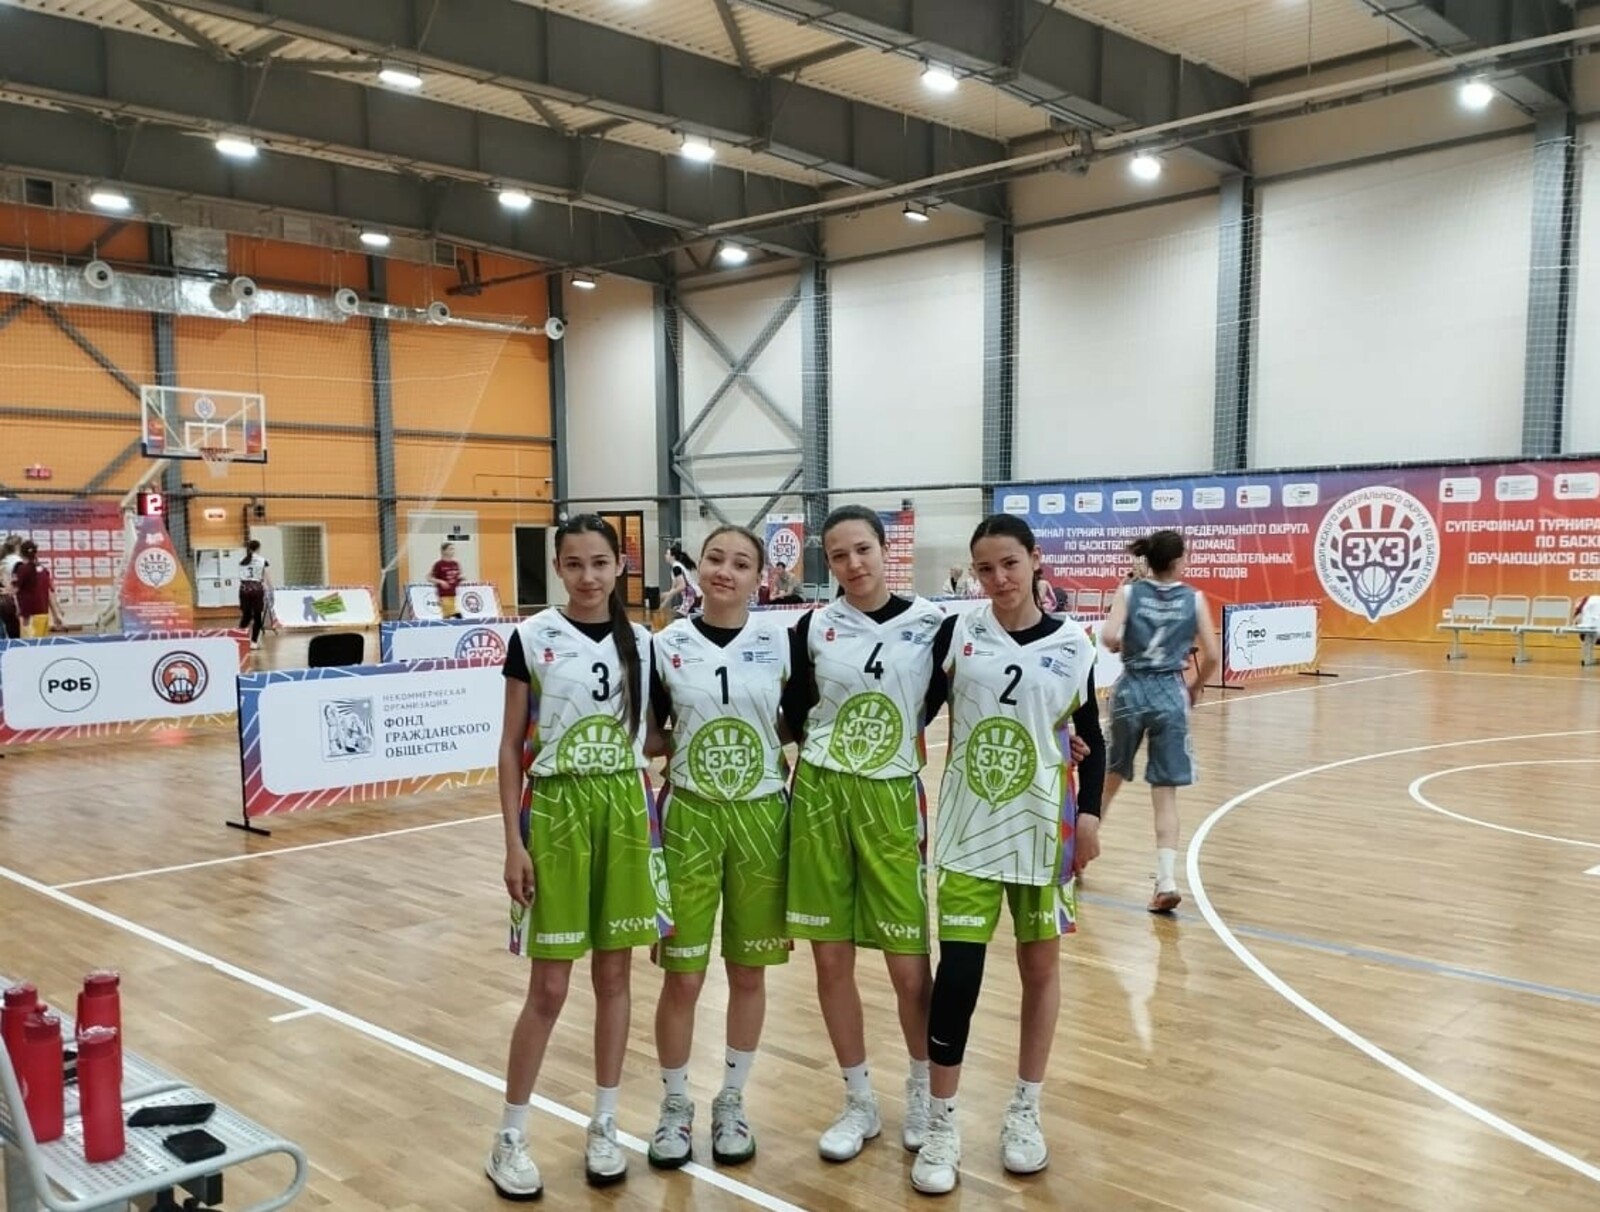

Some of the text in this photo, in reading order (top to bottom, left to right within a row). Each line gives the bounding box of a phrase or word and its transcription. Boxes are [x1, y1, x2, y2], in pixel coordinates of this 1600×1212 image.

[1031, 528, 1064, 538] ФИНАЛ
[1067, 527, 1105, 538] ТУРНИРА
[1185, 524, 1266, 536] ФЕДЕРАЛЬНОГО
[1268, 523, 1309, 535] ОКРУГА
[1445, 519, 1534, 532] СУПЕРФИНАЛ
[1064, 540, 1077, 551] ПО
[1192, 539, 1236, 551] КОМАНД
[1535, 535, 1555, 548] ПО
[1345, 537, 1405, 566] 3X3
[1468, 552, 1575, 565] ОБУЧАЮЩИХСЯ
[1041, 553, 1085, 565] АЮЩИХСЯ
[1190, 553, 1294, 564] ОБРАЗОВАТЕЛЬНЫХ
[1054, 565, 1116, 578] ОРГАНИЗАЦИЙ
[1181, 568, 1210, 578] -2025
[1213, 568, 1248, 578] ГОДОВ
[864, 642, 884, 680] 4
[48, 677, 92, 693] РФБ
[591, 662, 610, 701] 3
[715, 666, 729, 704] 1
[999, 664, 1023, 705] 2
[382, 688, 466, 701] НЕКОММЕРЧЕСКАЯ
[383, 699, 449, 712] ОРГАНИЗАЦИЯ
[384, 714, 424, 728] ФОНД
[385, 722, 491, 743] ГРАЖДАНСКОГО
[385, 741, 458, 759] ОБЩЕСТВА
